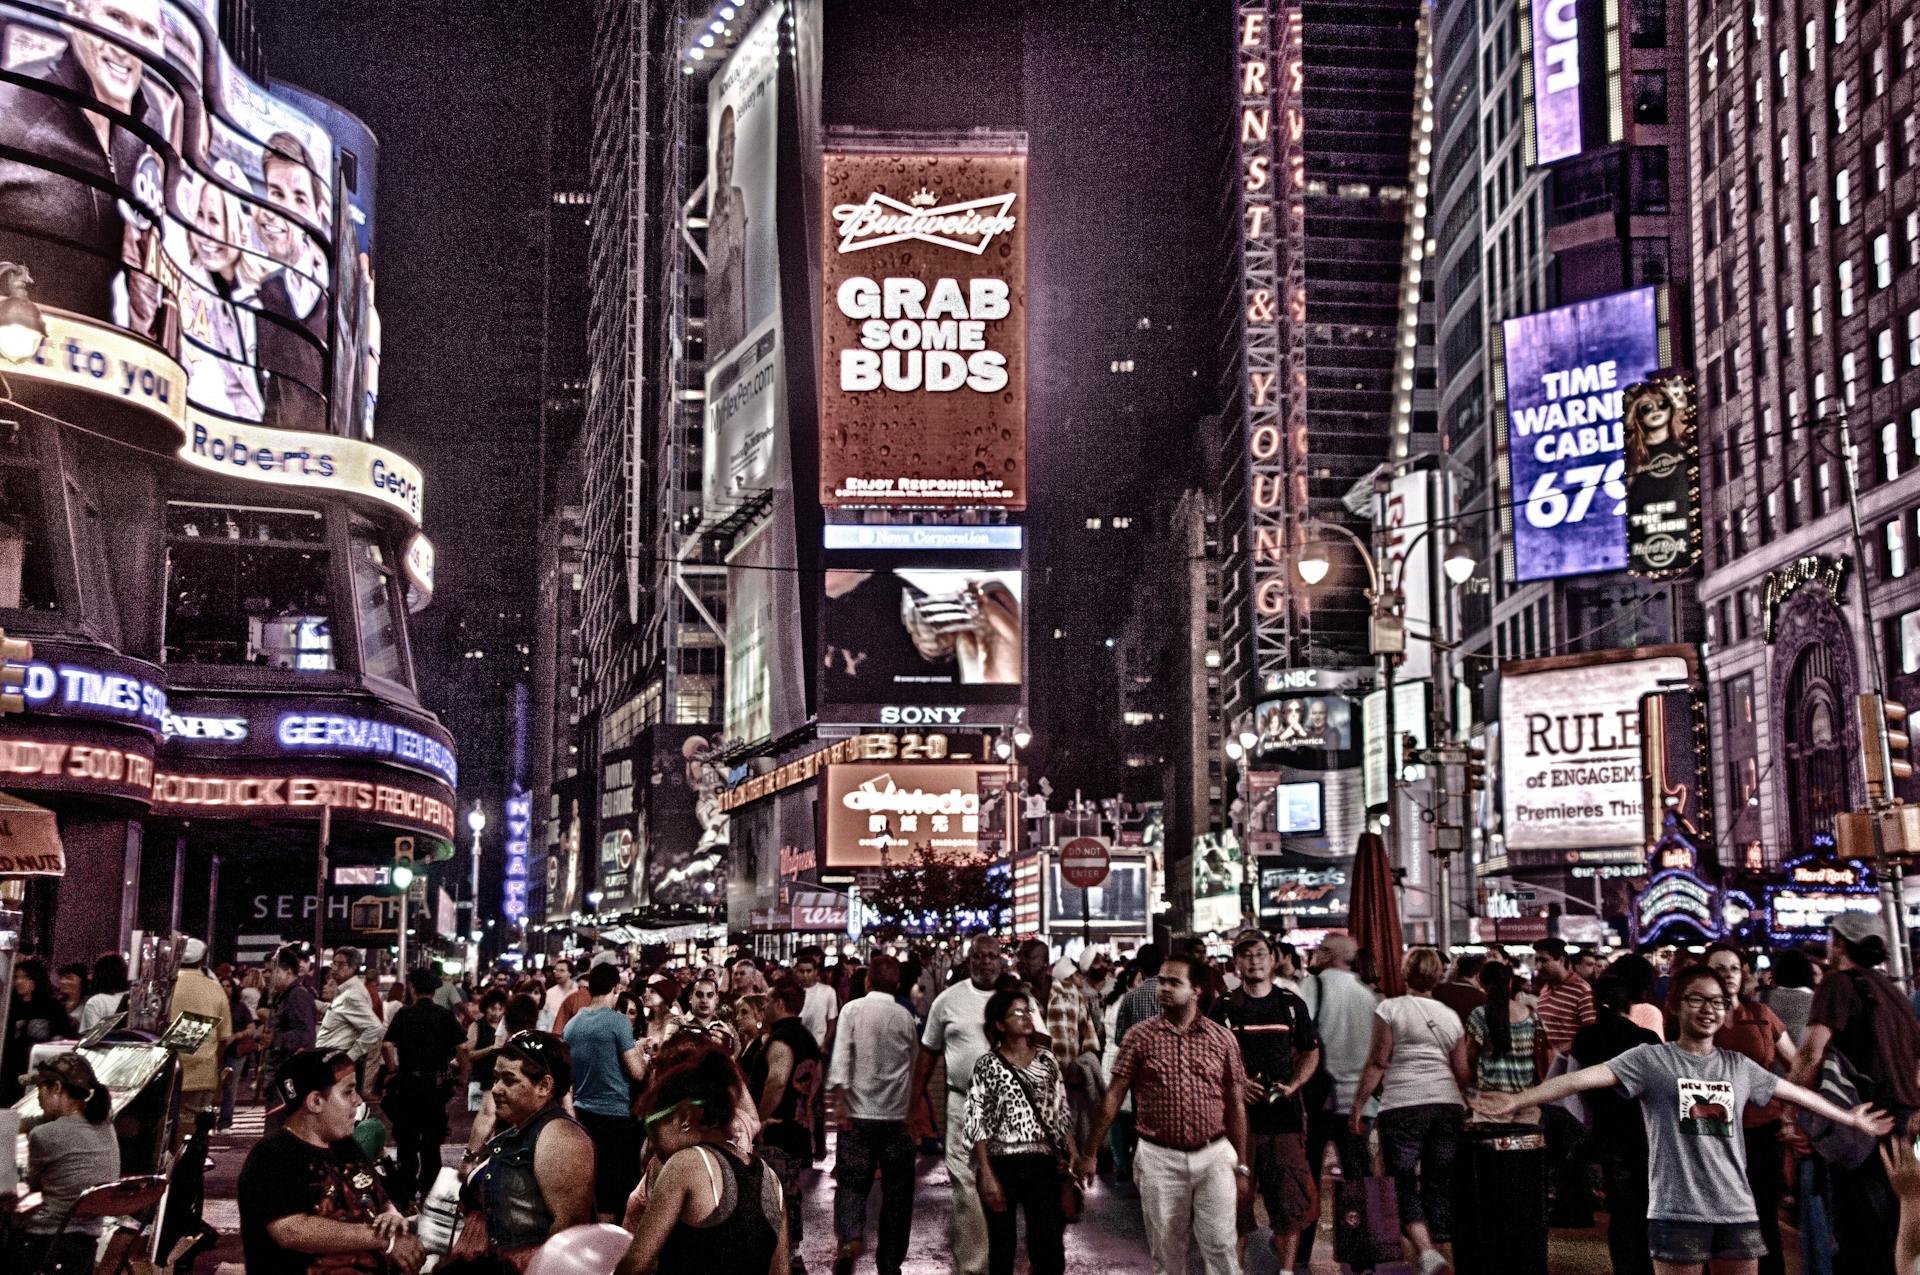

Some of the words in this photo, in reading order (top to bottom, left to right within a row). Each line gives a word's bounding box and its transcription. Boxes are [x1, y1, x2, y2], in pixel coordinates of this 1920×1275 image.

[1242, 14, 1270, 239] ERNST
[832, 204, 1016, 237] Budweiser
[836, 276, 1012, 320] GRAB
[1249, 289, 1275, 321] &
[860, 319, 987, 351] SOME
[65, 336, 107, 379] to
[119, 359, 171, 406] you
[840, 349, 1010, 393] BUDS
[1541, 360, 1617, 401] TIME
[192, 422, 334, 478] Roberts
[846, 477, 895, 491] ENJOY
[1251, 374, 1284, 614] YOUNG
[876, 531, 910, 546] News
[913, 530, 990, 546] Corporation
[1284, 669, 1317, 687] NBC
[880, 706, 966, 724] SONY
[278, 715, 395, 751] GERMAN
[68, 746, 124, 780] 500
[1526, 771, 1547, 789] of
[1516, 804, 1605, 821] Premieres
[1068, 847, 1081, 856] DO
[1083, 847, 1100, 857] NOT
[1071, 869, 1100, 878] ENTER
[1793, 867, 1825, 882] Hard
[1826, 868, 1856, 885] Rock
[252, 894, 432, 920] SEPHRA
[1705, 1084, 1731, 1093] YORK
